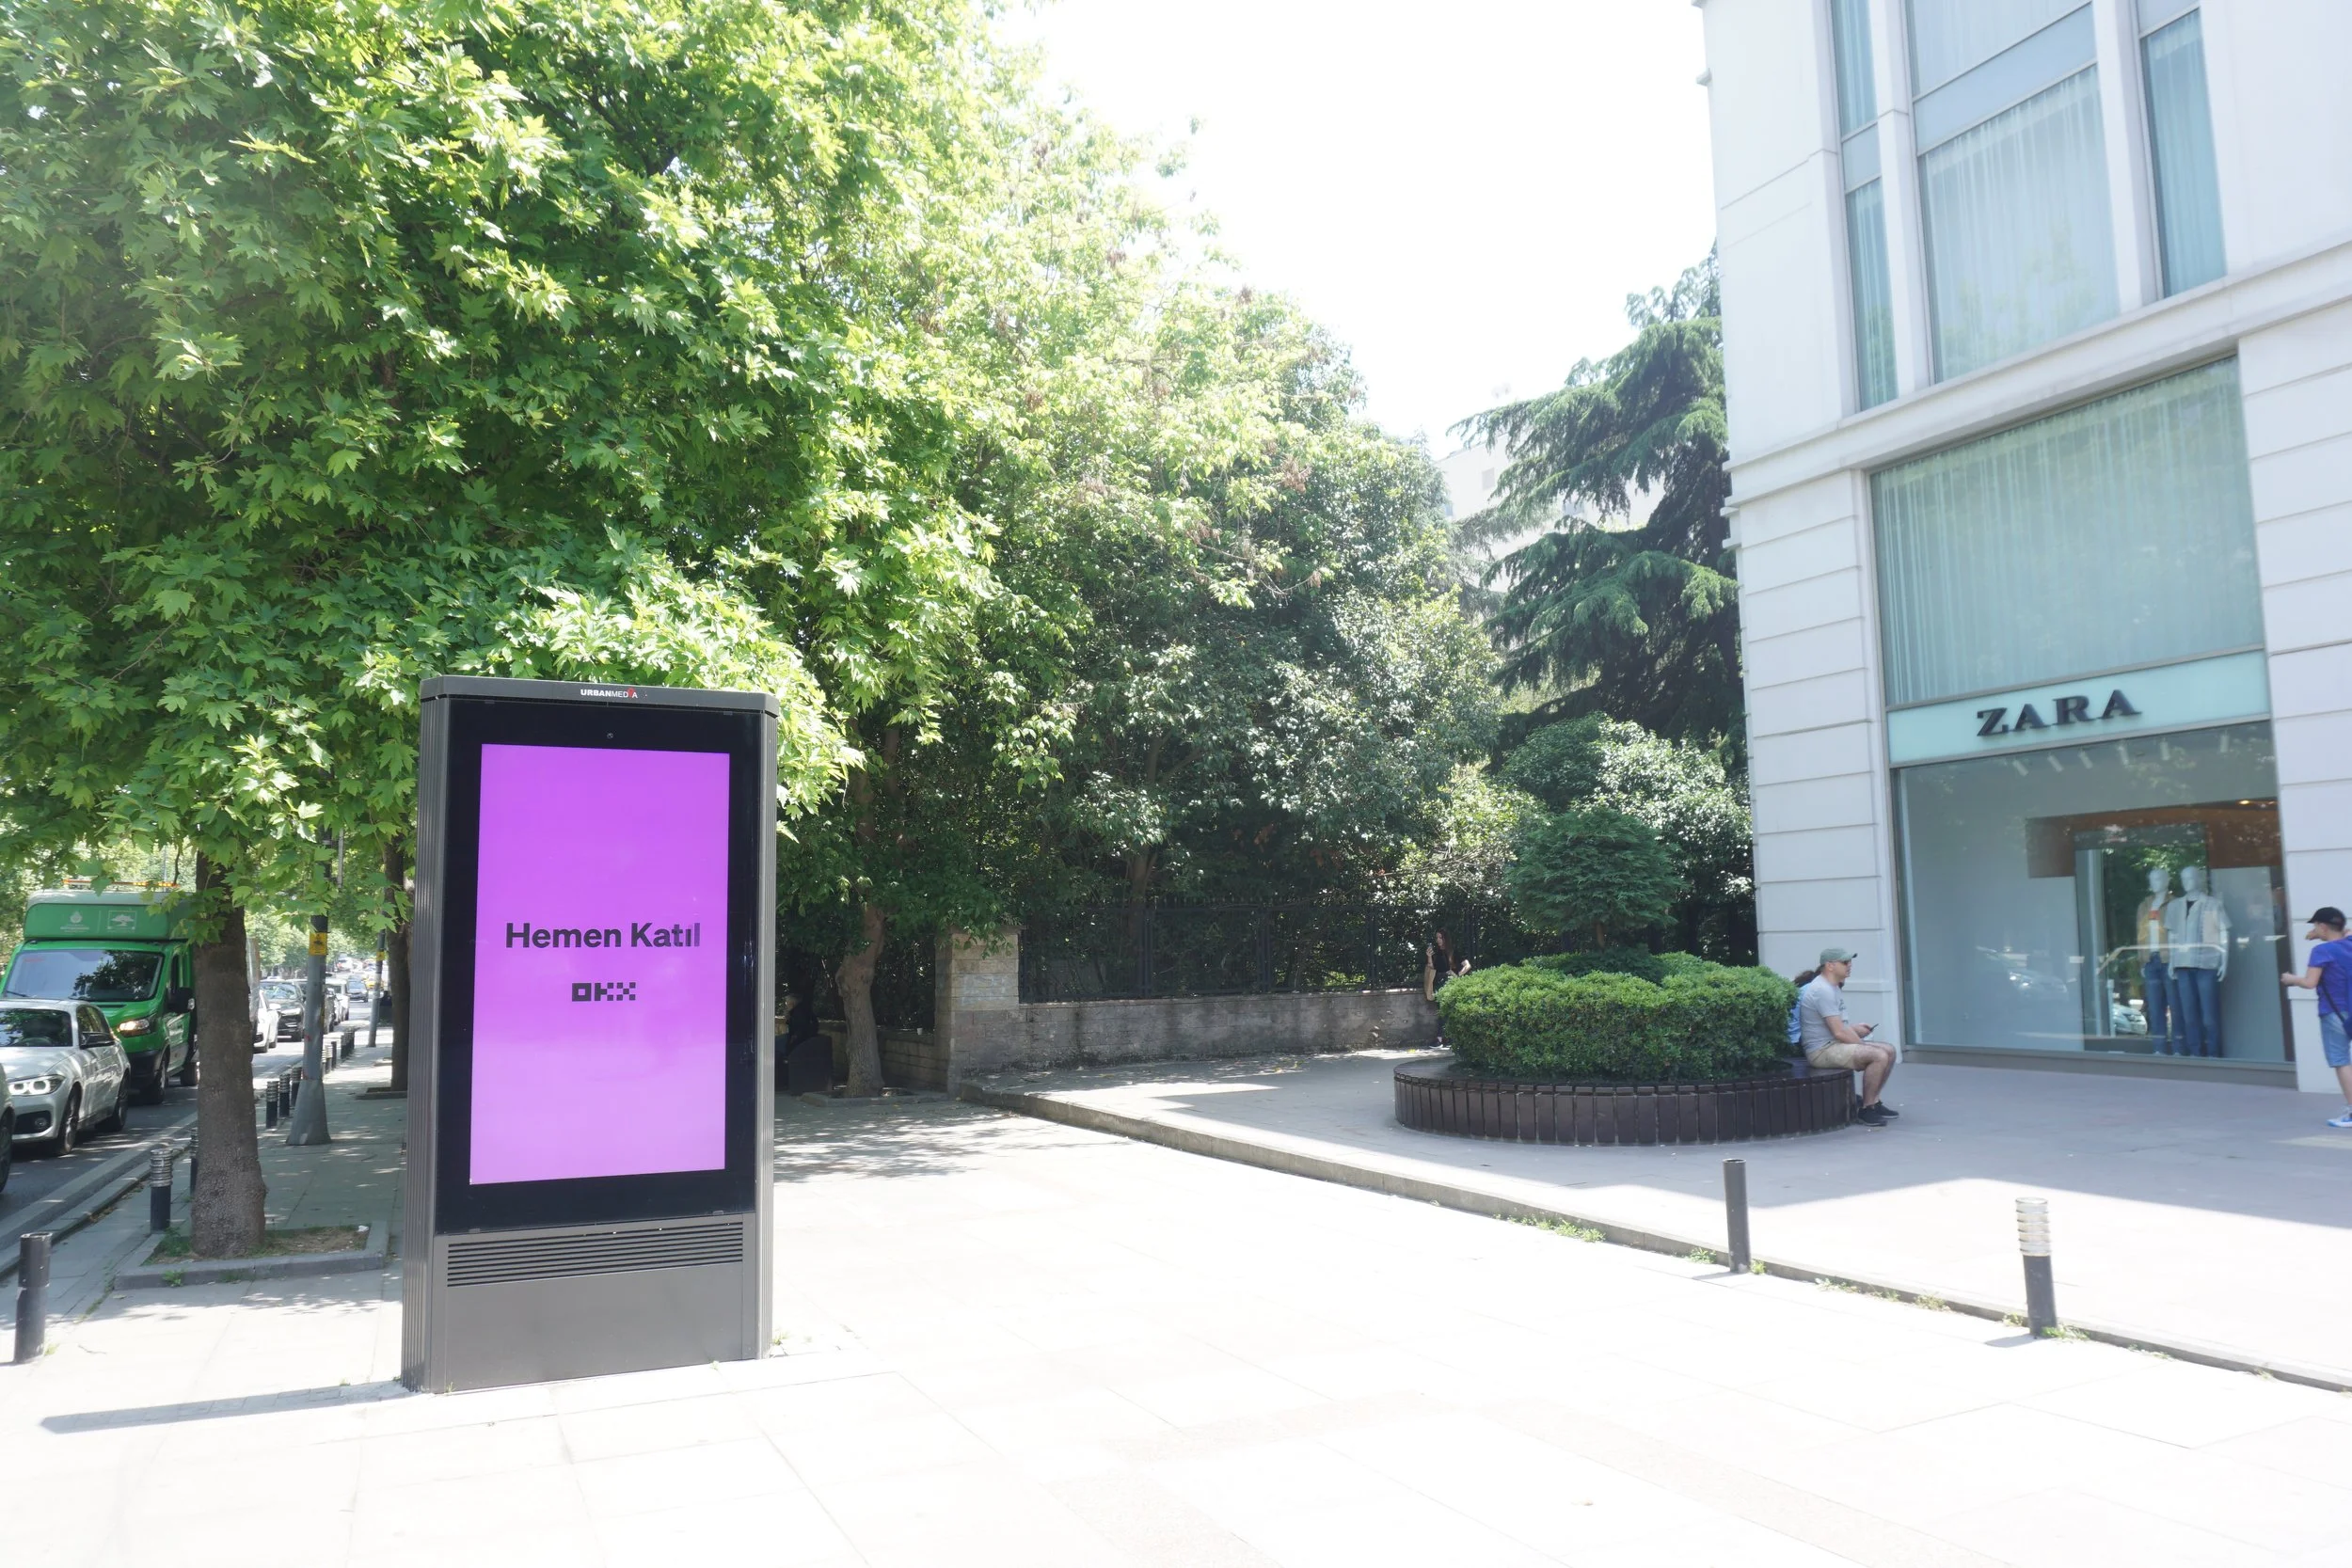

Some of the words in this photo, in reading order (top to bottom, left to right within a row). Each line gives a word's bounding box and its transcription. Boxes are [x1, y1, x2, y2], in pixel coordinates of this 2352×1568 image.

[1977, 689, 2142, 736] ZARA
[505, 922, 622, 948] Hemen
[571, 982, 636, 1002] OKX
